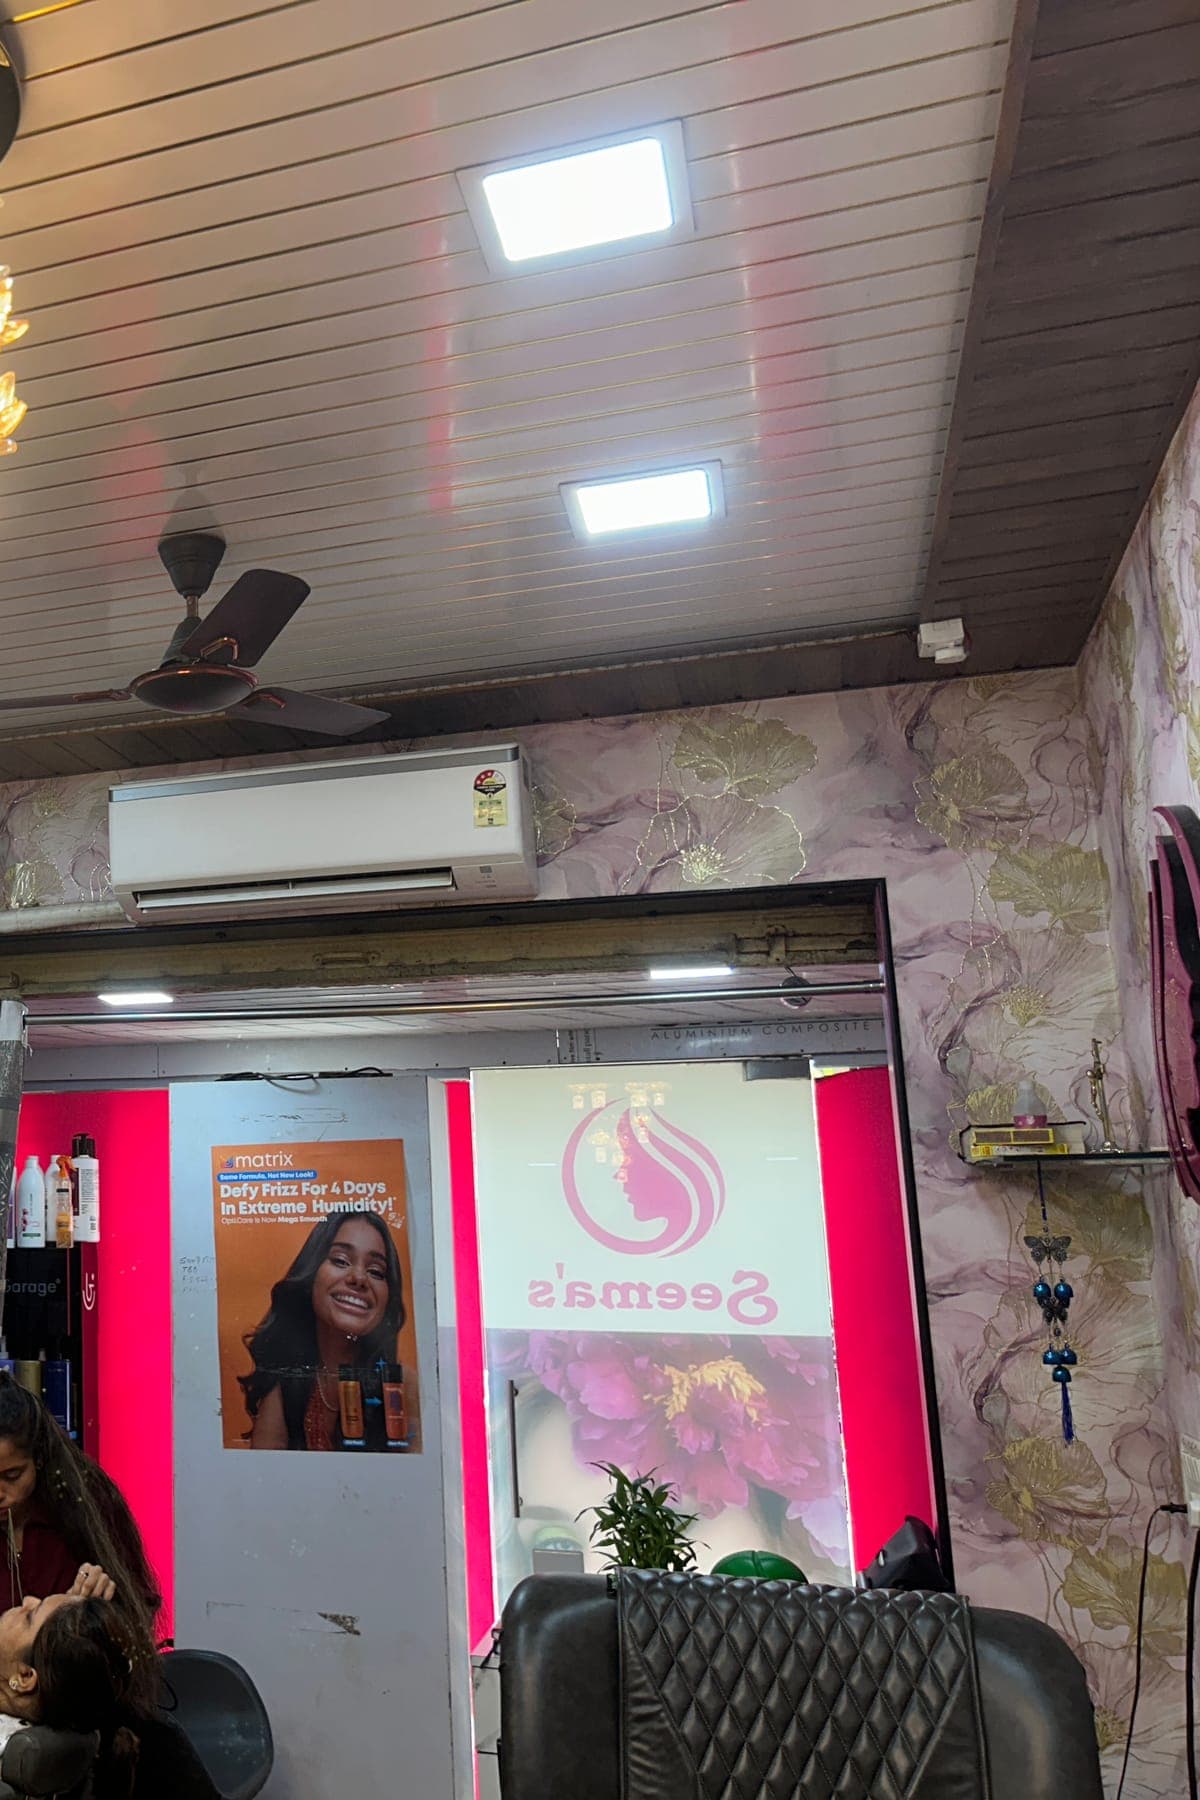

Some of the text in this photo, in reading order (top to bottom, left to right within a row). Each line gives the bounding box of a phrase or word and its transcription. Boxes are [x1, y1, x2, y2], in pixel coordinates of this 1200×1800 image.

[651, 1027, 752, 1041] ALUMINIUM
[762, 1021, 870, 1035] COMPOSITE
[235, 1151, 293, 1168] matrix
[220, 1181, 387, 1200] Defy Frizz For 4 Days
[221, 1196, 393, 1215] In Extreme Humidity!
[277, 1216, 298, 1225] Mega
